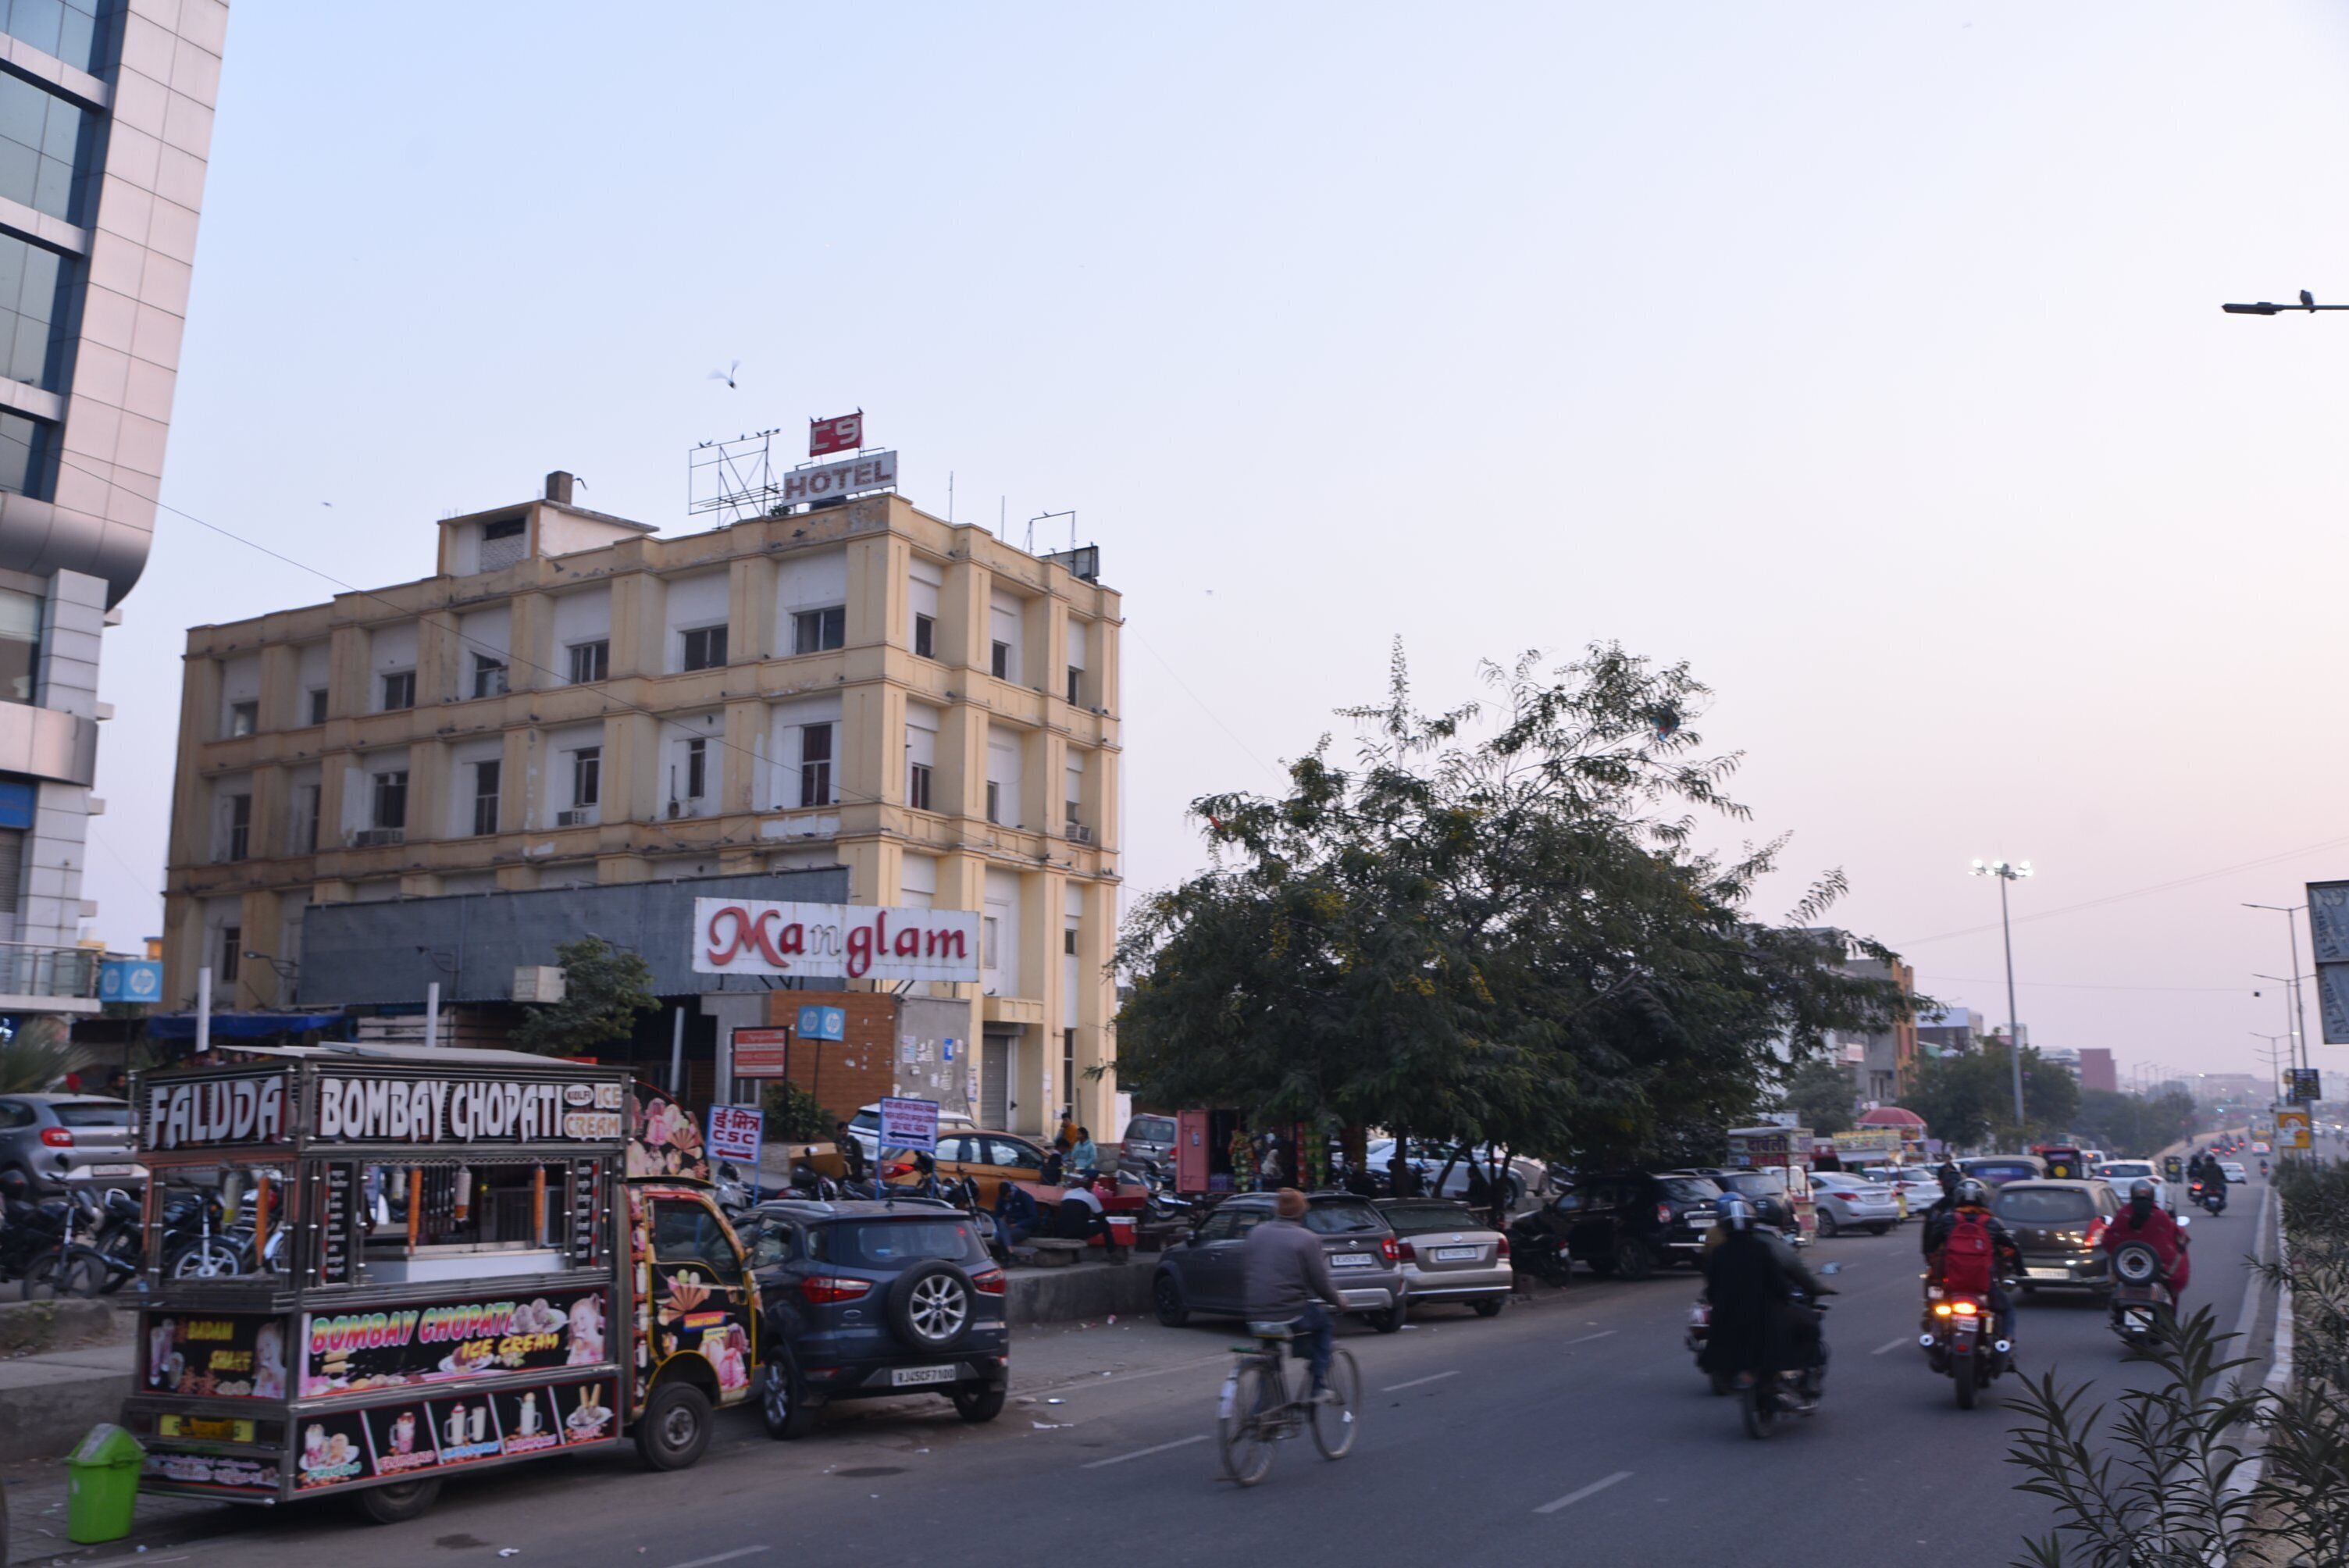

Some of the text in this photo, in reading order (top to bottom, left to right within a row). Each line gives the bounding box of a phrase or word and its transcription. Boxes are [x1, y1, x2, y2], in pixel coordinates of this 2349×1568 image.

[785, 461, 893, 499] HOTEL
[708, 906, 968, 978] Manglam
[320, 1078, 448, 1143] BOMBAY
[451, 1082, 563, 1142] CHOPATI
[597, 1086, 621, 1106] ICE
[566, 1116, 620, 1136] CREAM
[714, 1129, 755, 1145] CSC
[310, 1302, 517, 1353] BOMBAY CHOPATI
[461, 1332, 559, 1359] ICE CREAM
